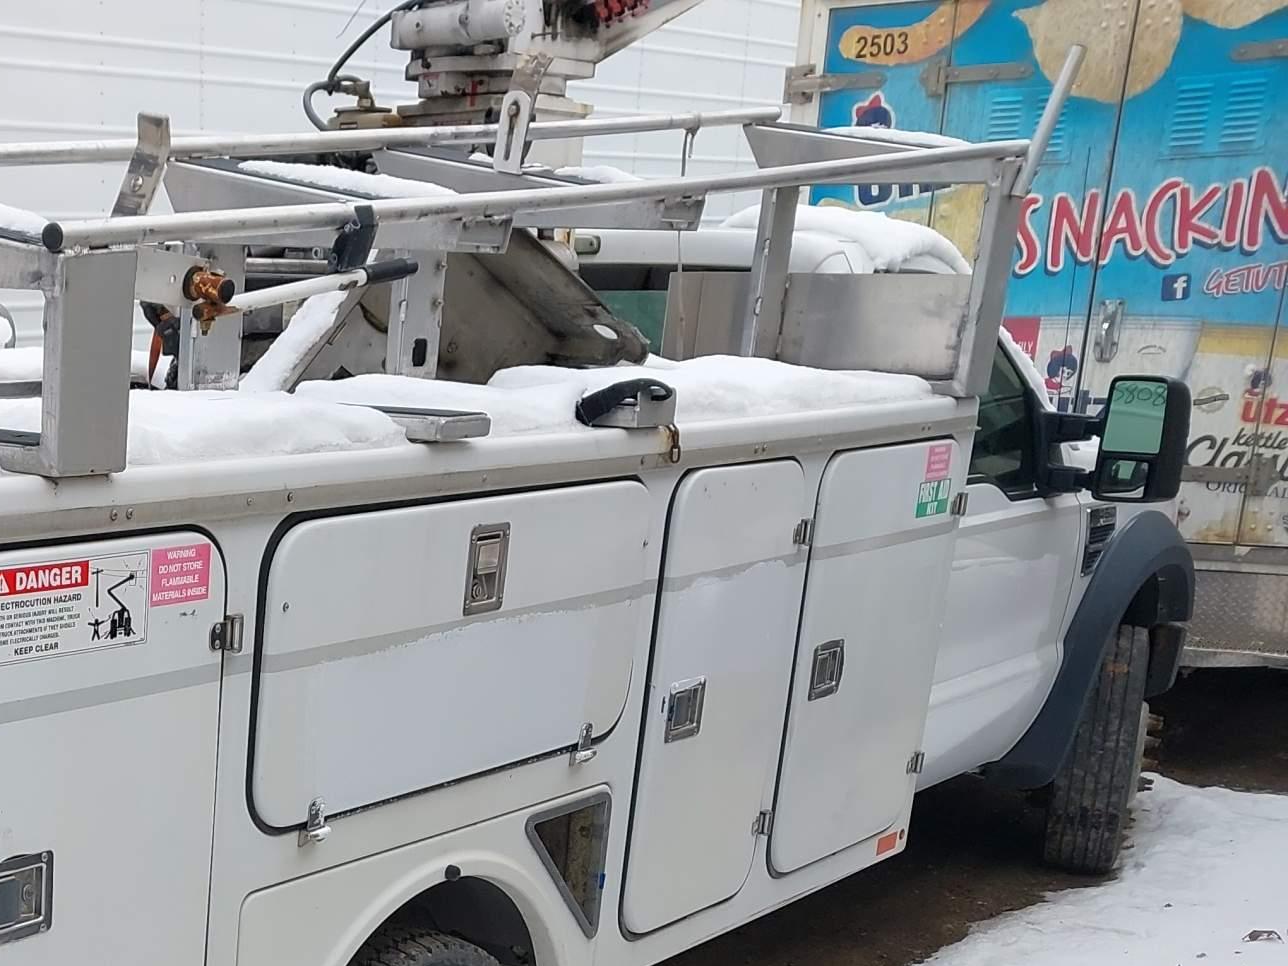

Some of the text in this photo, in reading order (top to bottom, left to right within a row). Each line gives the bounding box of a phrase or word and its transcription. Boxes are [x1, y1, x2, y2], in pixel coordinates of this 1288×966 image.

[855, 32, 909, 59] 2503
[1014, 167, 1288, 275] SNACKIN
[1204, 260, 1288, 298] GETUT
[167, 548, 196, 560] WARNING
[158, 560, 203, 574] DO NOT STORE
[15, 565, 82, 591] DANGER
[161, 574, 199, 587] FLAMMABLE
[53, 593, 82, 604] HAZARD
[152, 586, 207, 602] MATERIALS INSIDE
[14, 642, 59, 656] KEEP CLEAR
